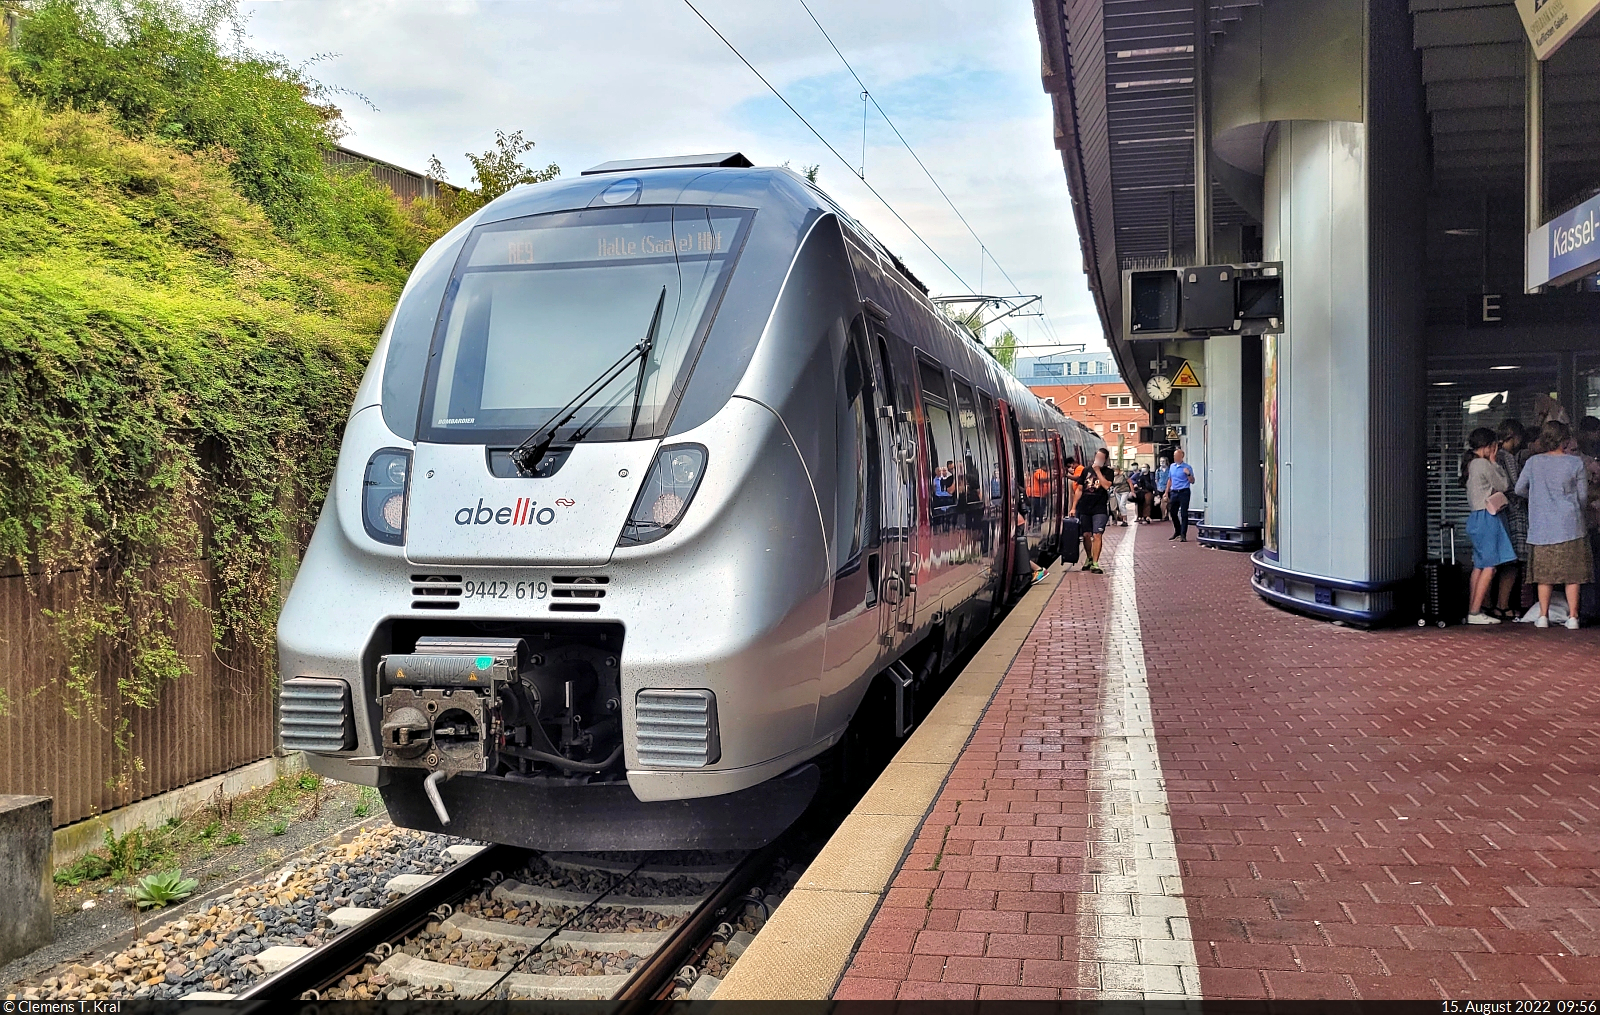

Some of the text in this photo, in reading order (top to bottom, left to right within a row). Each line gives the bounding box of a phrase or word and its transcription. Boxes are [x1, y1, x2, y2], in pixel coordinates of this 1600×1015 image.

[1553, 207, 1600, 258] Kassel-
[508, 231, 722, 264] RE9 Halle (Saale) Hbf
[1483, 295, 1501, 321] E
[454, 498, 556, 526] abellio
[464, 581, 548, 599] 9442 619
